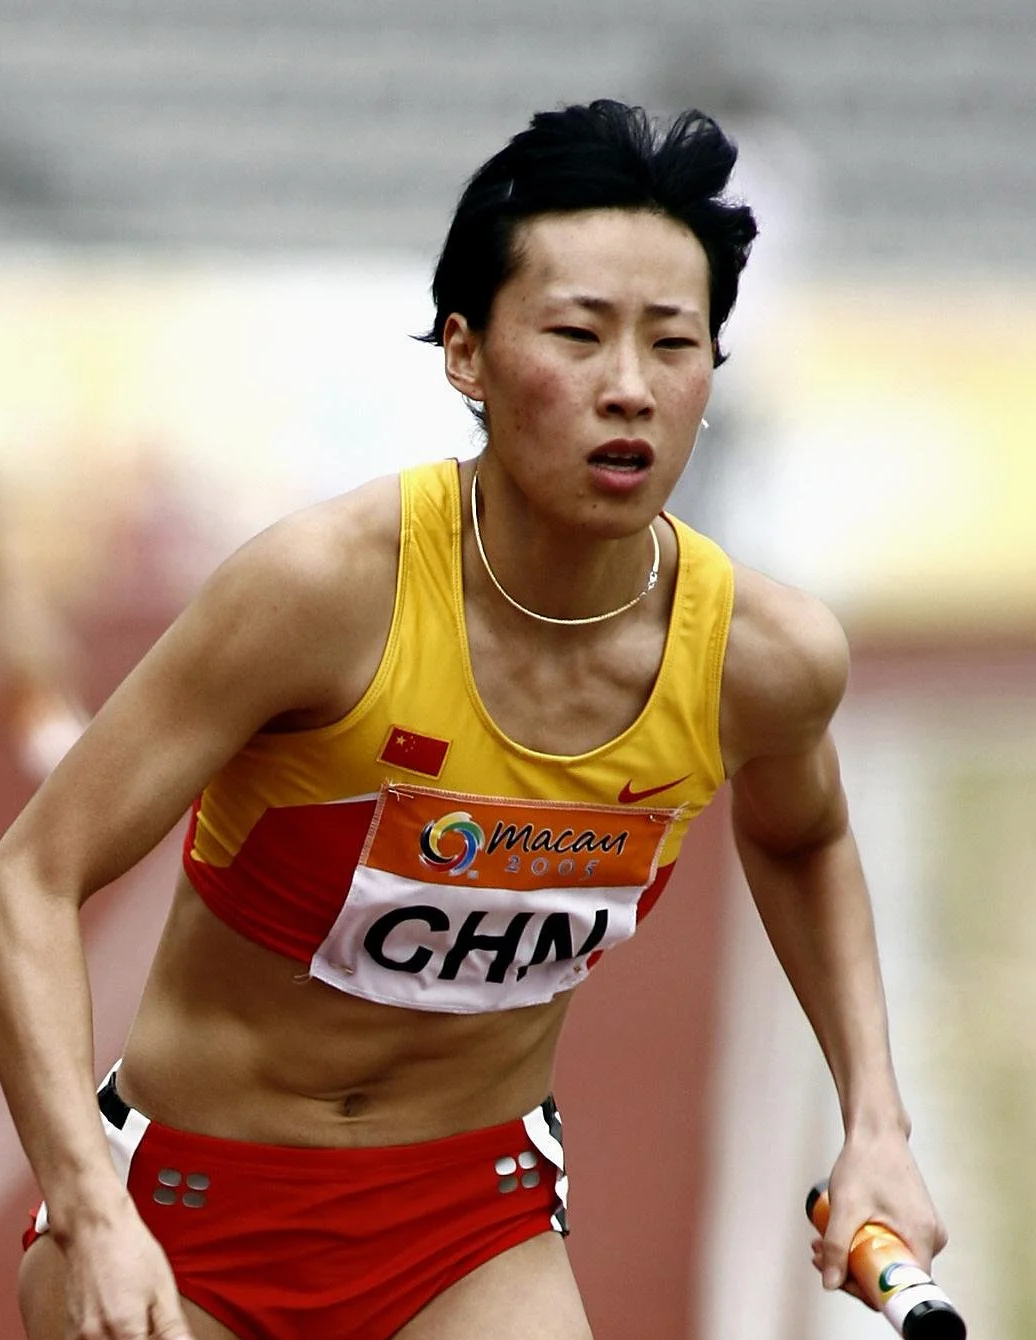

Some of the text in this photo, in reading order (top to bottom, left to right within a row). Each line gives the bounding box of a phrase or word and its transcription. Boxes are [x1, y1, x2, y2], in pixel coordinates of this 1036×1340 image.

[487, 819, 629, 856] Macau
[504, 855, 601, 880] 2005
[364, 904, 609, 984] CHN
